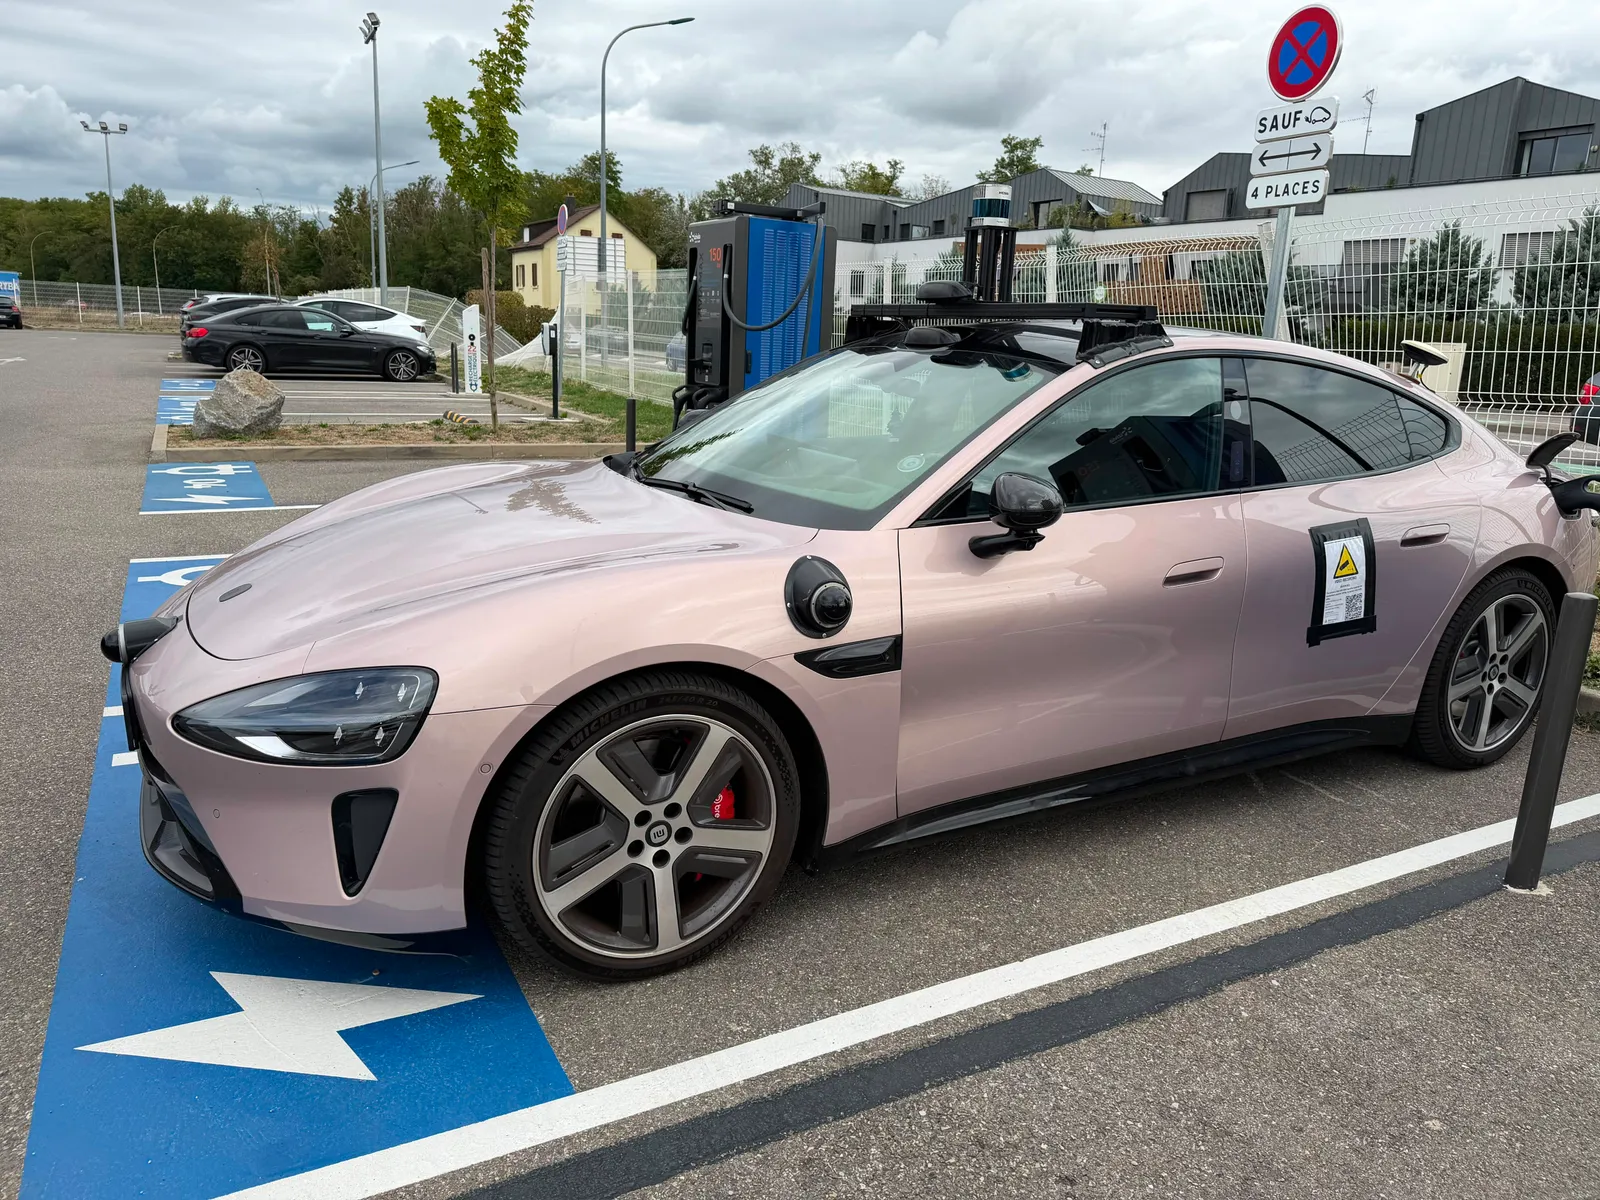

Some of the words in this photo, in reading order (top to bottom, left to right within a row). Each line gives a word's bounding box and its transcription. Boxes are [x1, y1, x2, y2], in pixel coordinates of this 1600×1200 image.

[1258, 110, 1302, 133] SAUF
[1251, 187, 1259, 200] 4
[1265, 180, 1320, 199] PLACES
[709, 247, 722, 262] 150
[571, 698, 649, 749] MICHELIN
